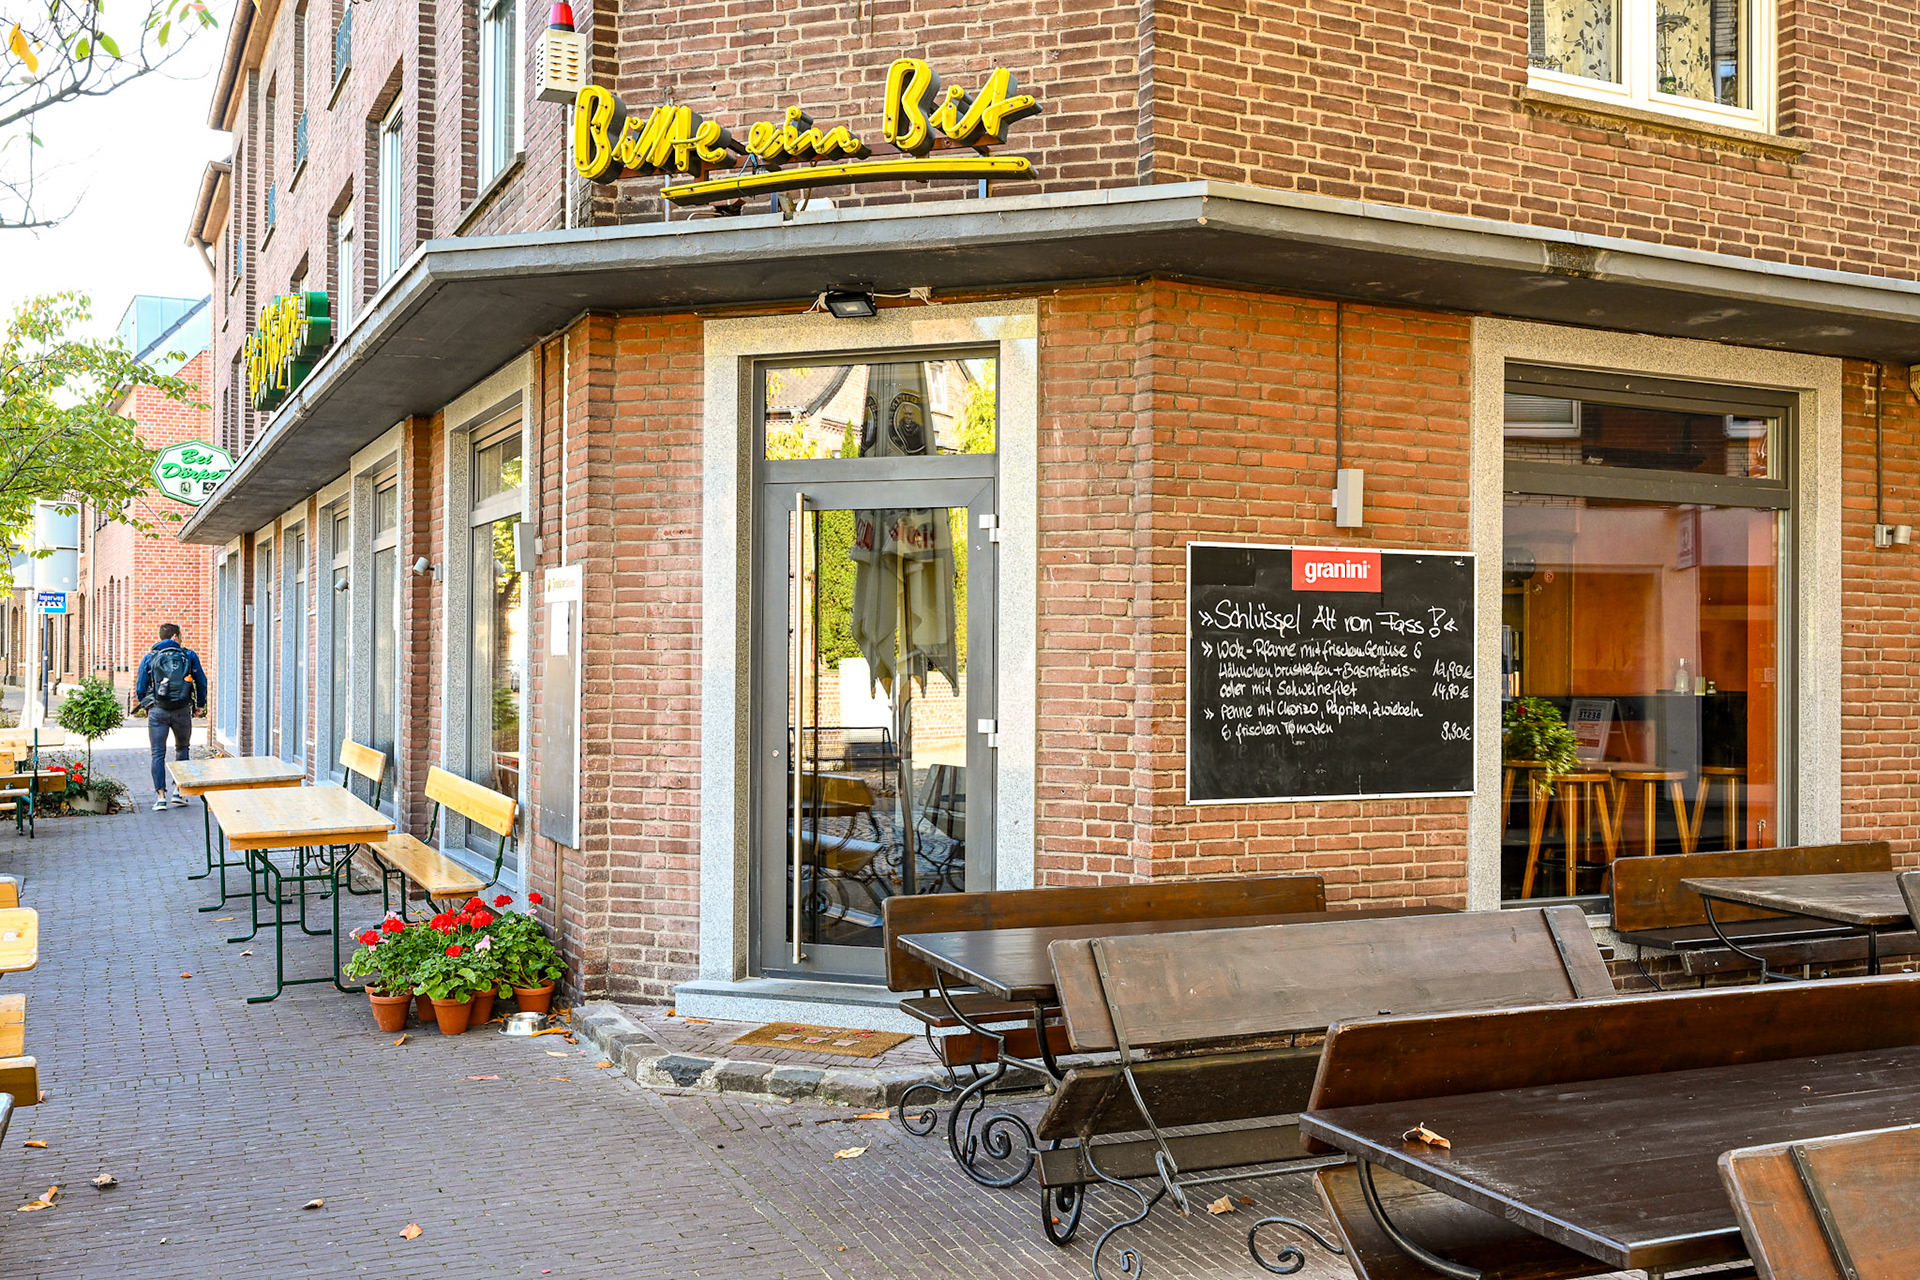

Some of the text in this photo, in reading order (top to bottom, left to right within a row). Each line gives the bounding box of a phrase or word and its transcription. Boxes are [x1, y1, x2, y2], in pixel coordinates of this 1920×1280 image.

[574, 57, 1040, 182] Bitte ein Bit
[180, 448, 213, 465] Bei
[161, 462, 226, 483] Dörper
[1304, 560, 1368, 583] granini
[1300, 641, 1321, 658] mit
[1220, 679, 1358, 703] oder mit Schweinefilet
[1220, 703, 1253, 720] Penne
[1257, 700, 1275, 717] mit
[1235, 721, 1281, 744] frischen
[1281, 719, 1334, 735] Tomaten
